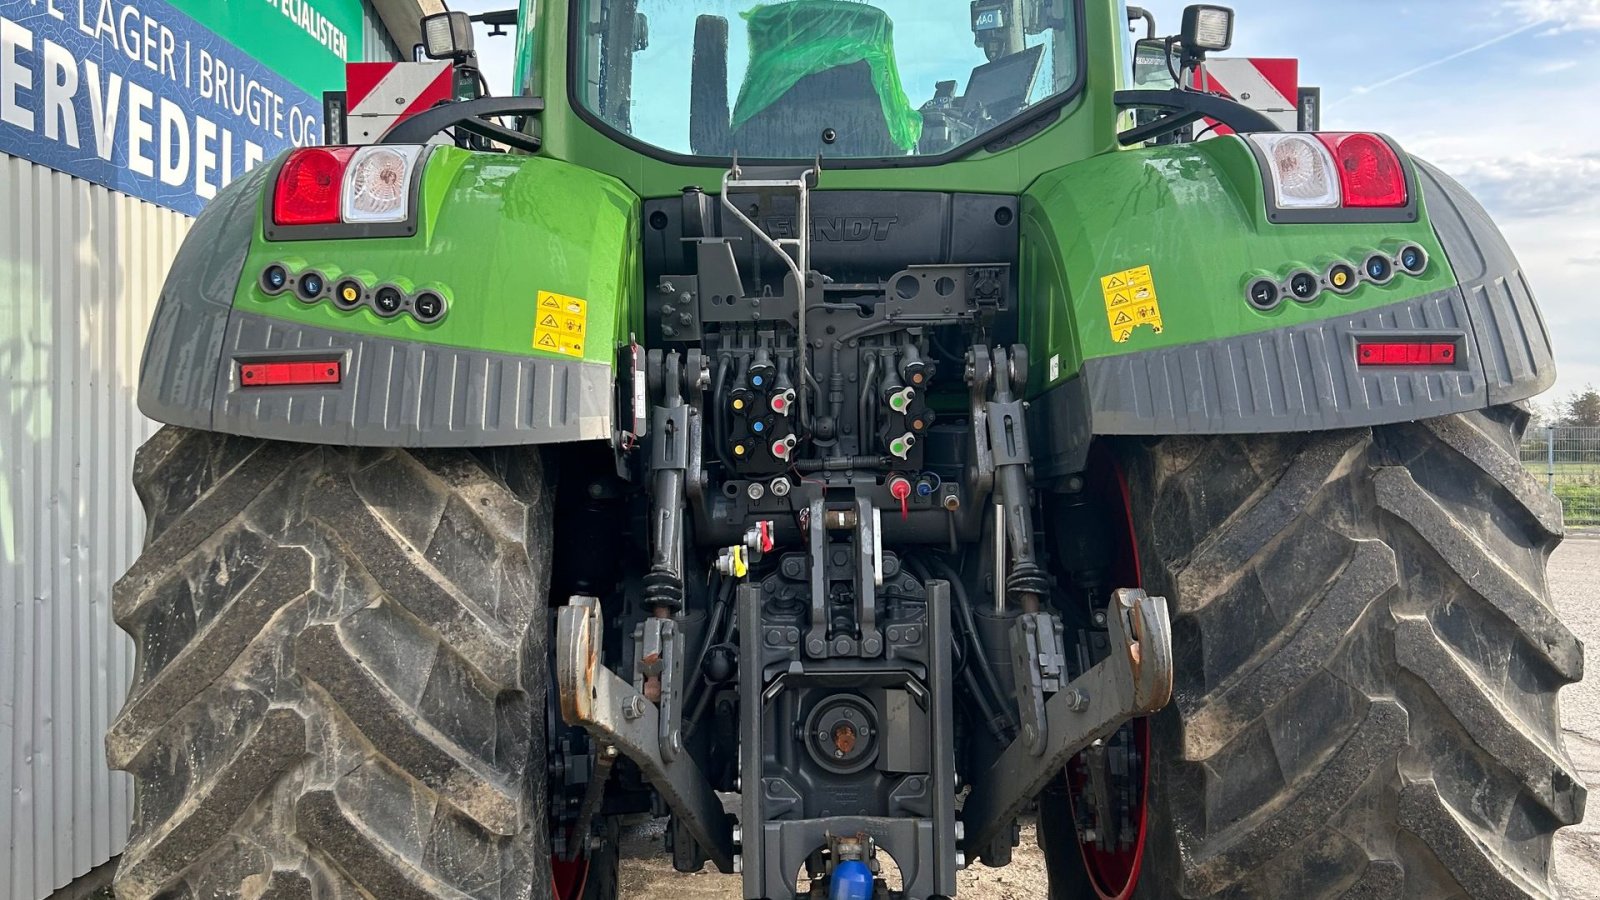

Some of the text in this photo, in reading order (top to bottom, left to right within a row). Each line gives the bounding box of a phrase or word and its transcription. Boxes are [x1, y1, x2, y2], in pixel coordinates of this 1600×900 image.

[267, 0, 347, 62] ECIALISTEN
[200, 49, 283, 139] BRUGTE
[290, 106, 316, 148] OG
